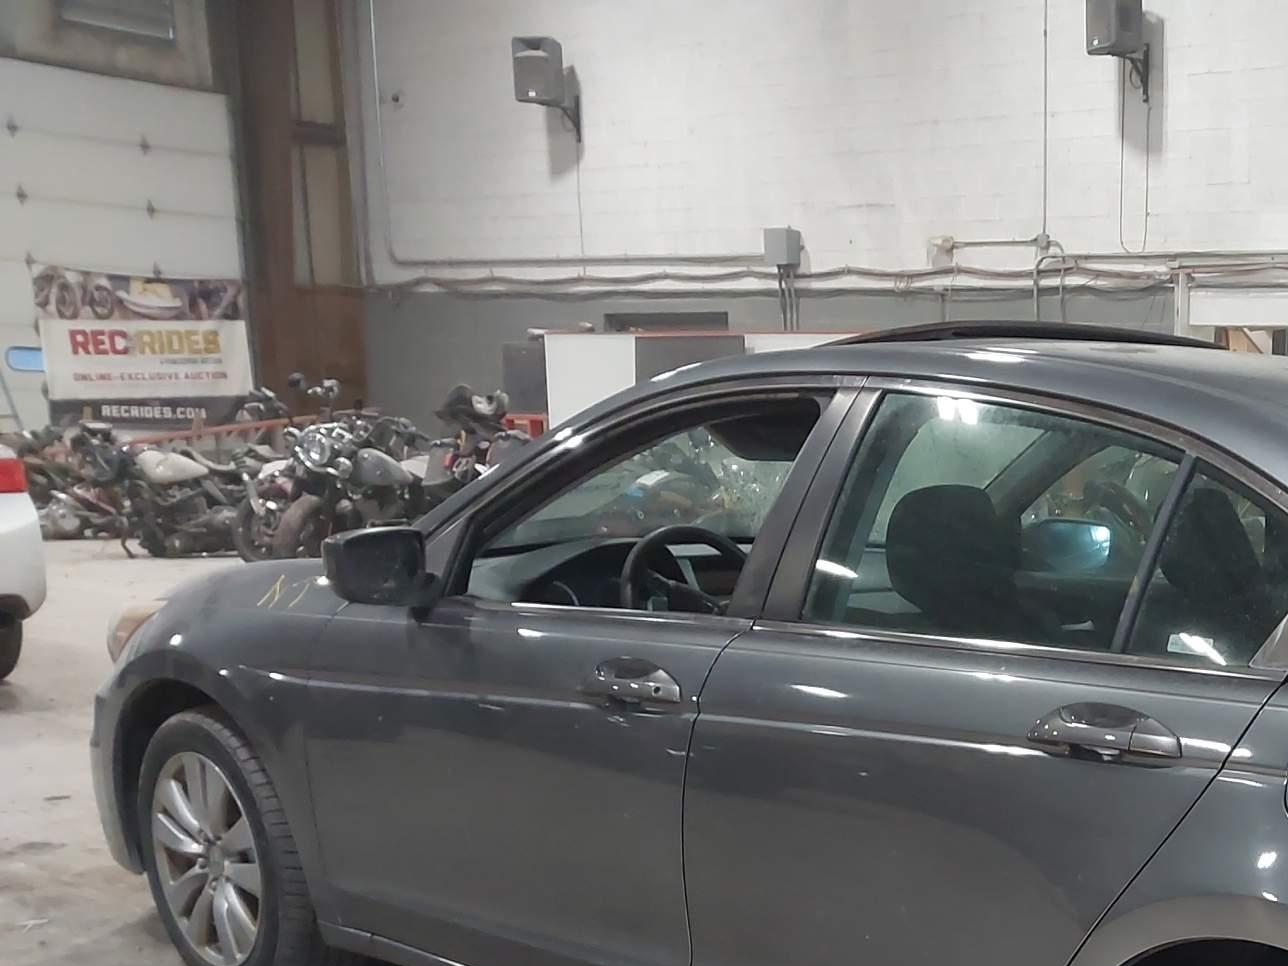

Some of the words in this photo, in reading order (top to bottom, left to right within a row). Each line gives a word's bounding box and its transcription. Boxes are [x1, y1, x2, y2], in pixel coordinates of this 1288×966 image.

[68, 329, 129, 356] REC
[135, 329, 221, 355] RIDES
[73, 371, 180, 382] ONLINE-EXCLUSIVE
[184, 371, 229, 381] AUCTION
